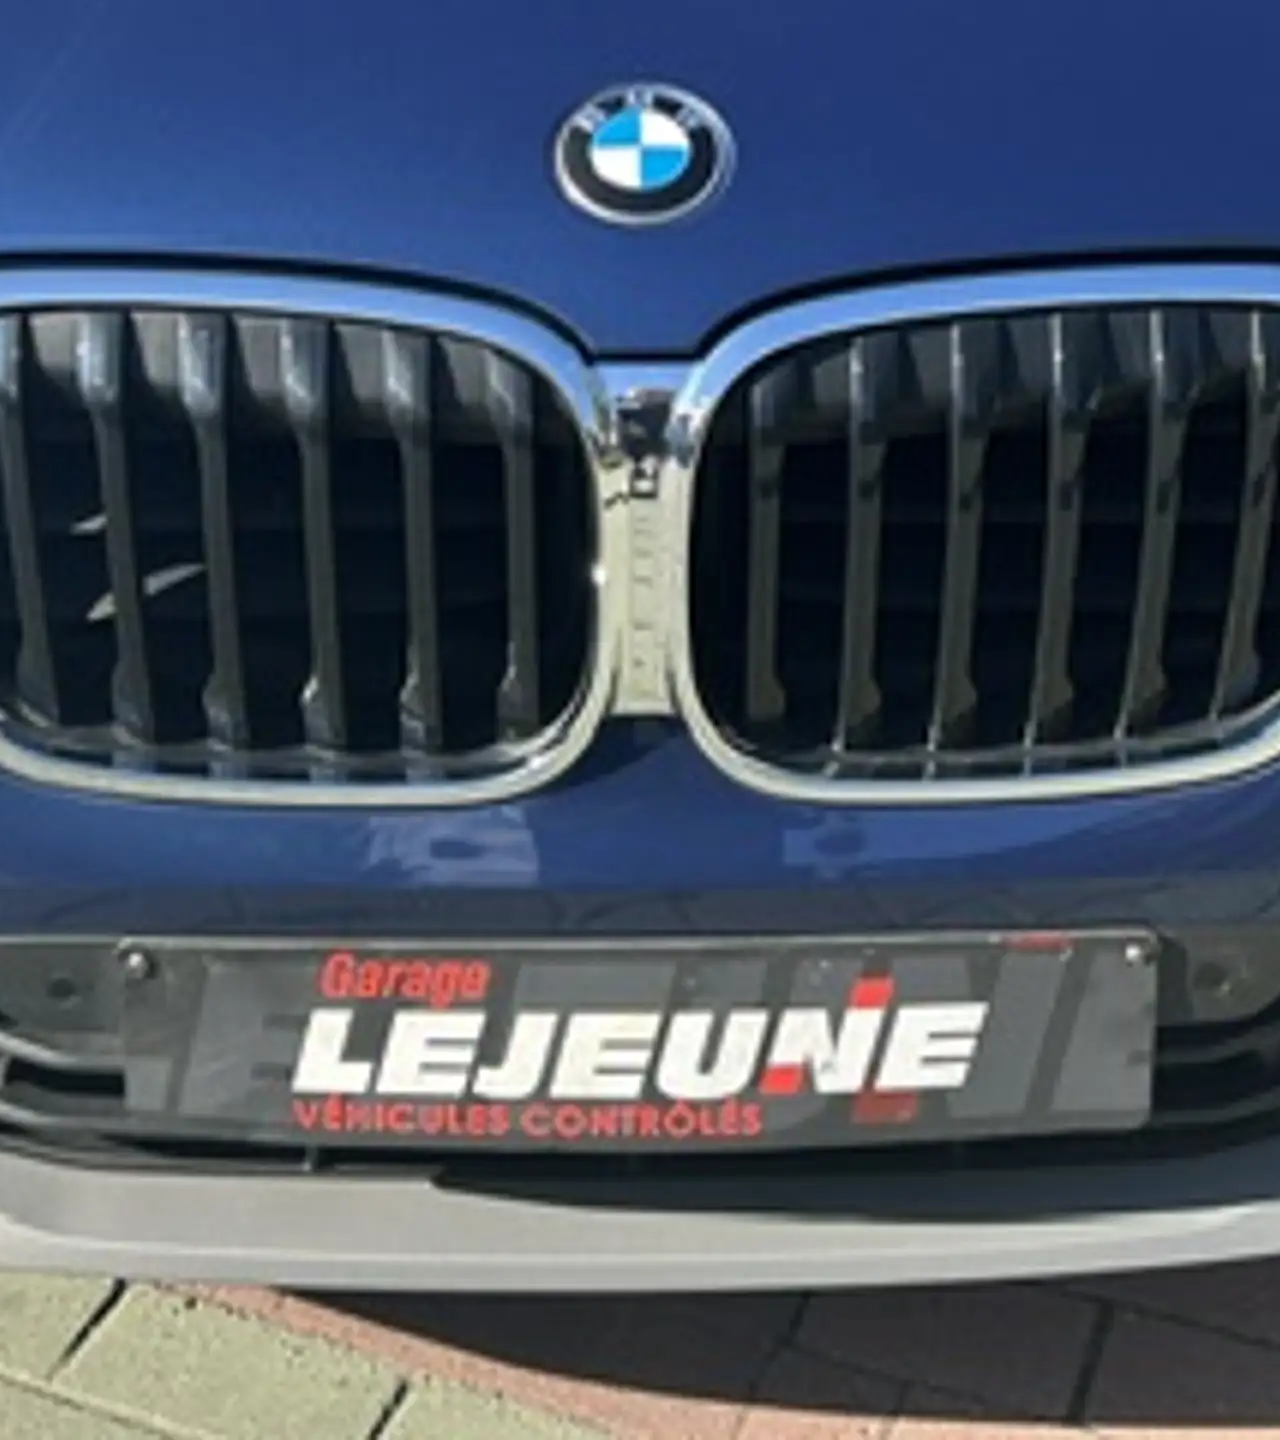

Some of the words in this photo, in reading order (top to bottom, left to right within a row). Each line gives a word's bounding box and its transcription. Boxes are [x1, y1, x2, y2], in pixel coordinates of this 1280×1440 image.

[319, 950, 491, 1011] Garage
[291, 1000, 989, 1102] LEJEUNE
[293, 1094, 510, 1135] VÉHICULES
[521, 1095, 763, 1138] CONTRÔLÉS
